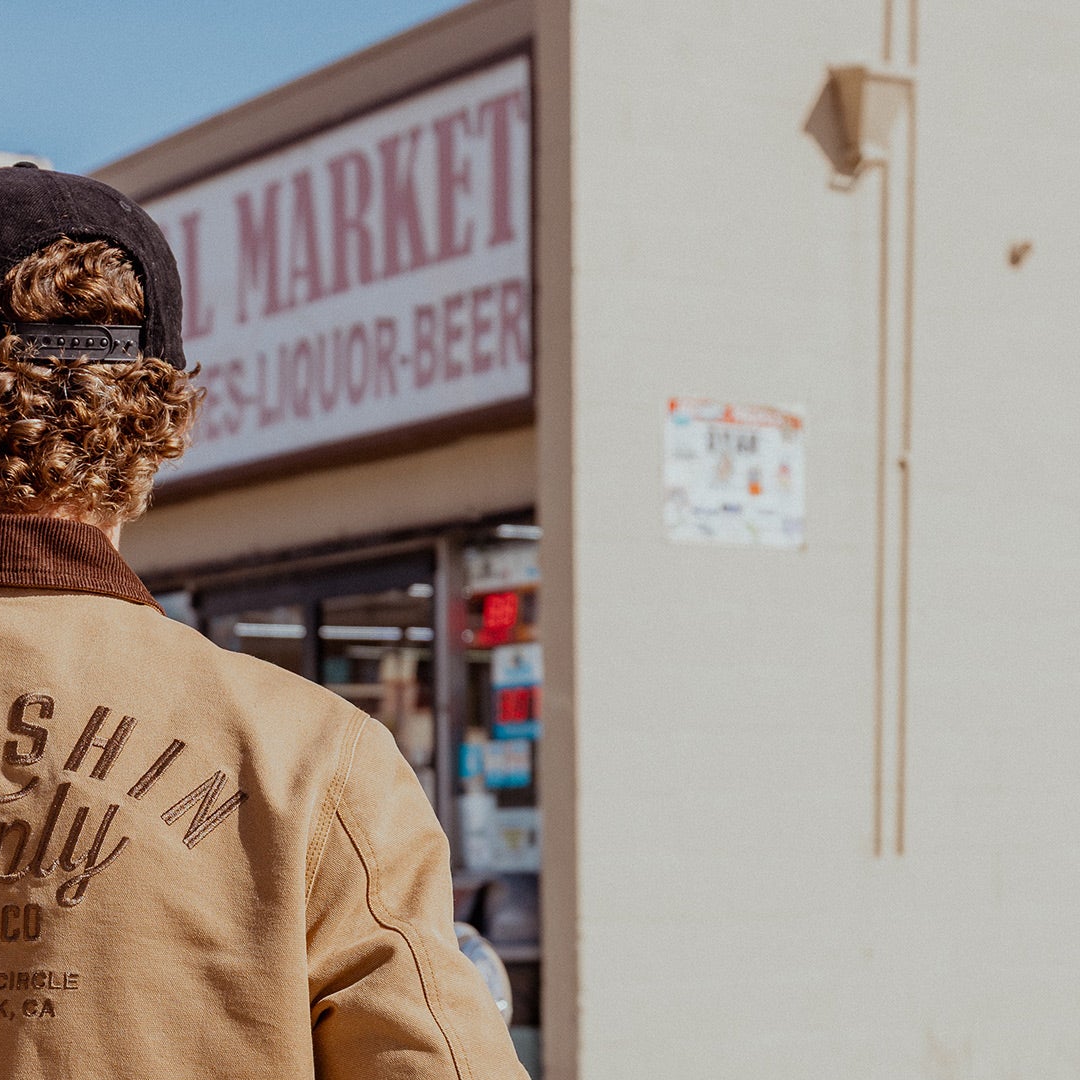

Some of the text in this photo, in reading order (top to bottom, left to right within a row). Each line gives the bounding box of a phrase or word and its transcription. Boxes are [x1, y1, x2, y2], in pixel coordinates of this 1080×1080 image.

[234, 91, 528, 326] MARKET
[196, 278, 527, 440] ES-LIQUOR-BEER
[0, 903, 42, 942] CO
[22, 998, 57, 1019] CA
